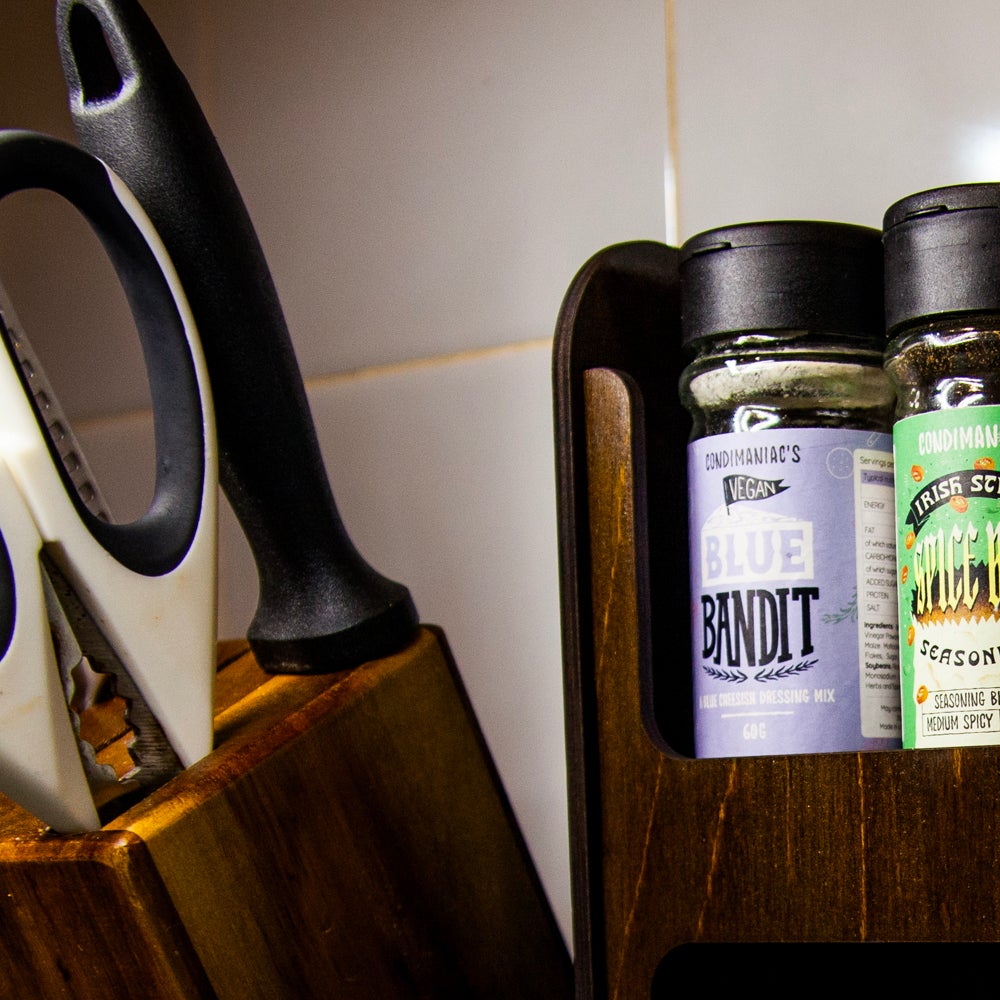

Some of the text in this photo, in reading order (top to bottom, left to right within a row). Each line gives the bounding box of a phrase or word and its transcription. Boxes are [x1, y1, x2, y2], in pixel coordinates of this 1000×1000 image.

[706, 445, 800, 471] CONDIMANIAC'S
[729, 478, 776, 501] VEGAN
[915, 475, 963, 516] IRISH
[705, 529, 806, 580] BLUE
[914, 521, 979, 615] SPICE
[867, 604, 880, 612] SALT
[700, 586, 820, 667] BANDIT
[760, 689, 809, 705] DRESSING
[814, 688, 836, 703] MIX
[934, 691, 986, 709] SEASONING
[743, 722, 767, 740] 60G
[926, 713, 994, 732] MEDIUM SPICY
